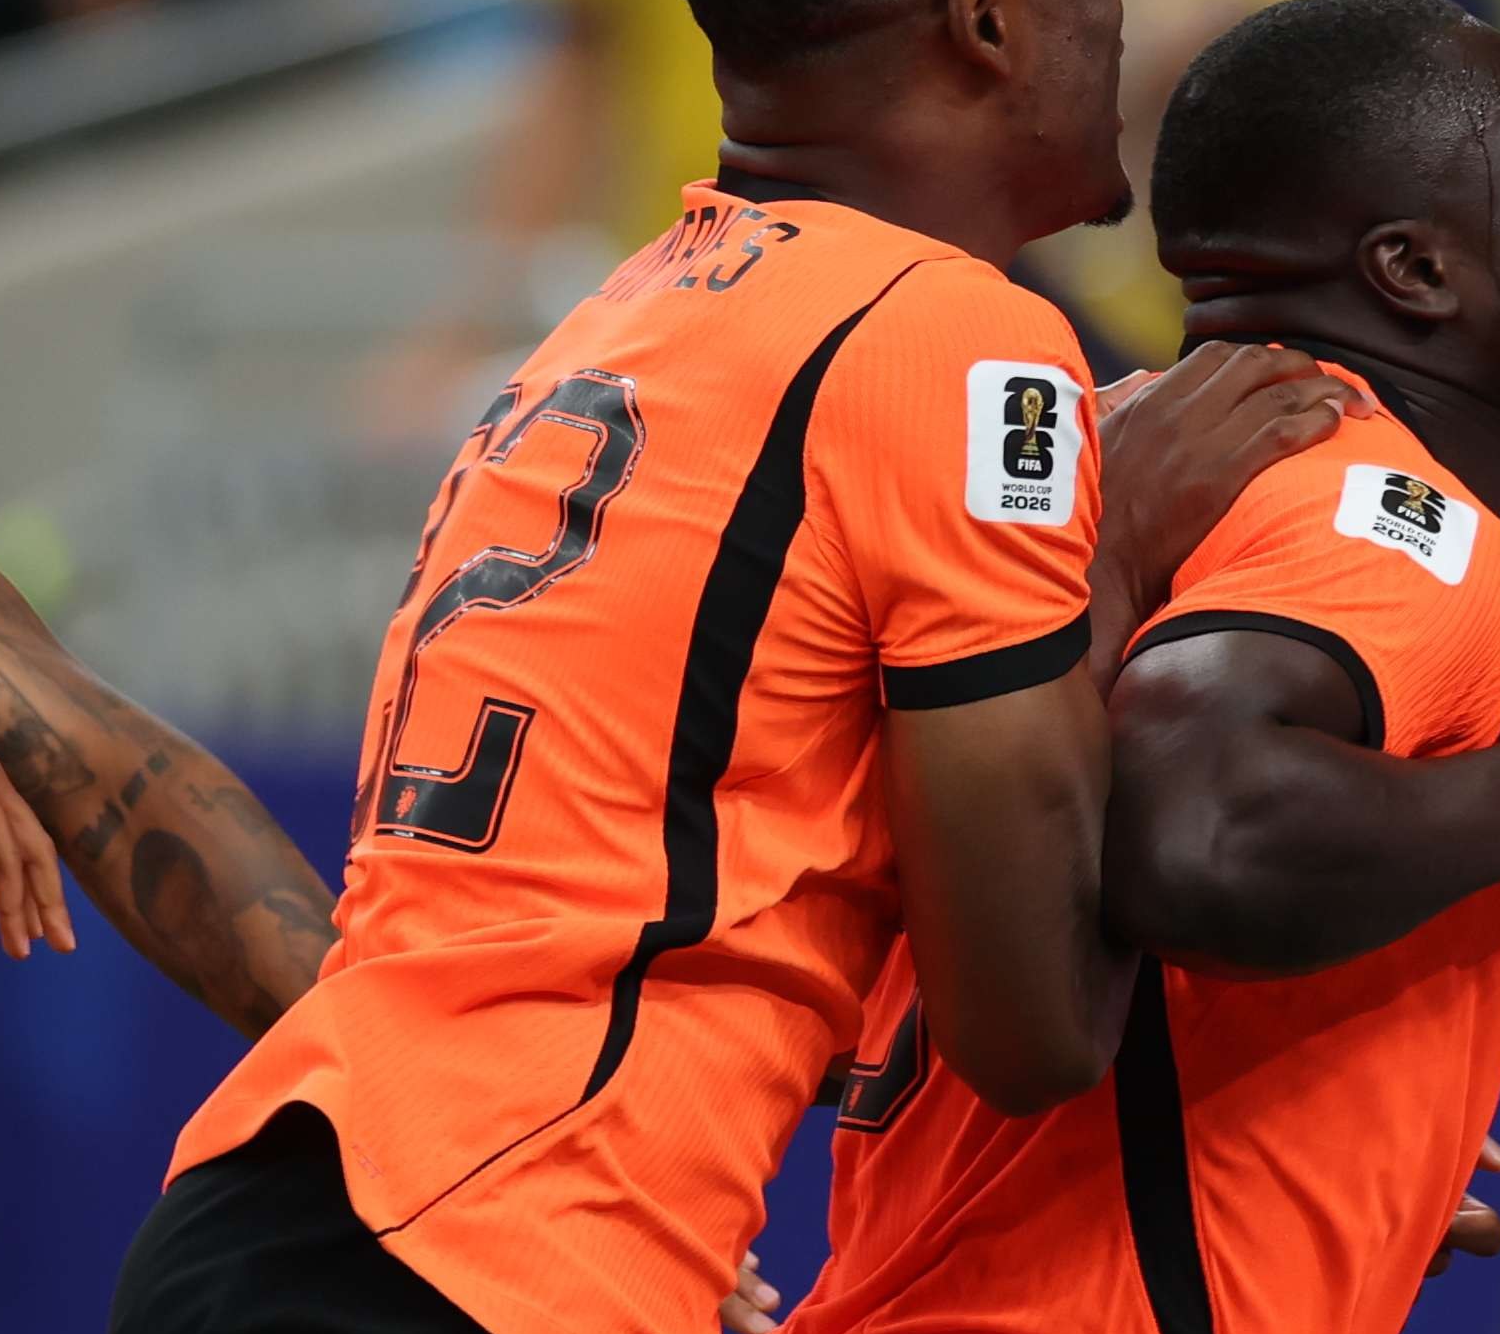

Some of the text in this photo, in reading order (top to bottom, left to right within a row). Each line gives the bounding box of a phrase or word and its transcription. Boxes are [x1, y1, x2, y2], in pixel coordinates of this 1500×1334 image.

[1016, 458, 1043, 472] FIFA
[1002, 482, 1053, 495] WORLD CUP
[1000, 494, 1052, 512] 2026
[1376, 514, 1416, 535] WORLD
[1396, 504, 1427, 526] FIFA
[1372, 522, 1433, 558] 2026
